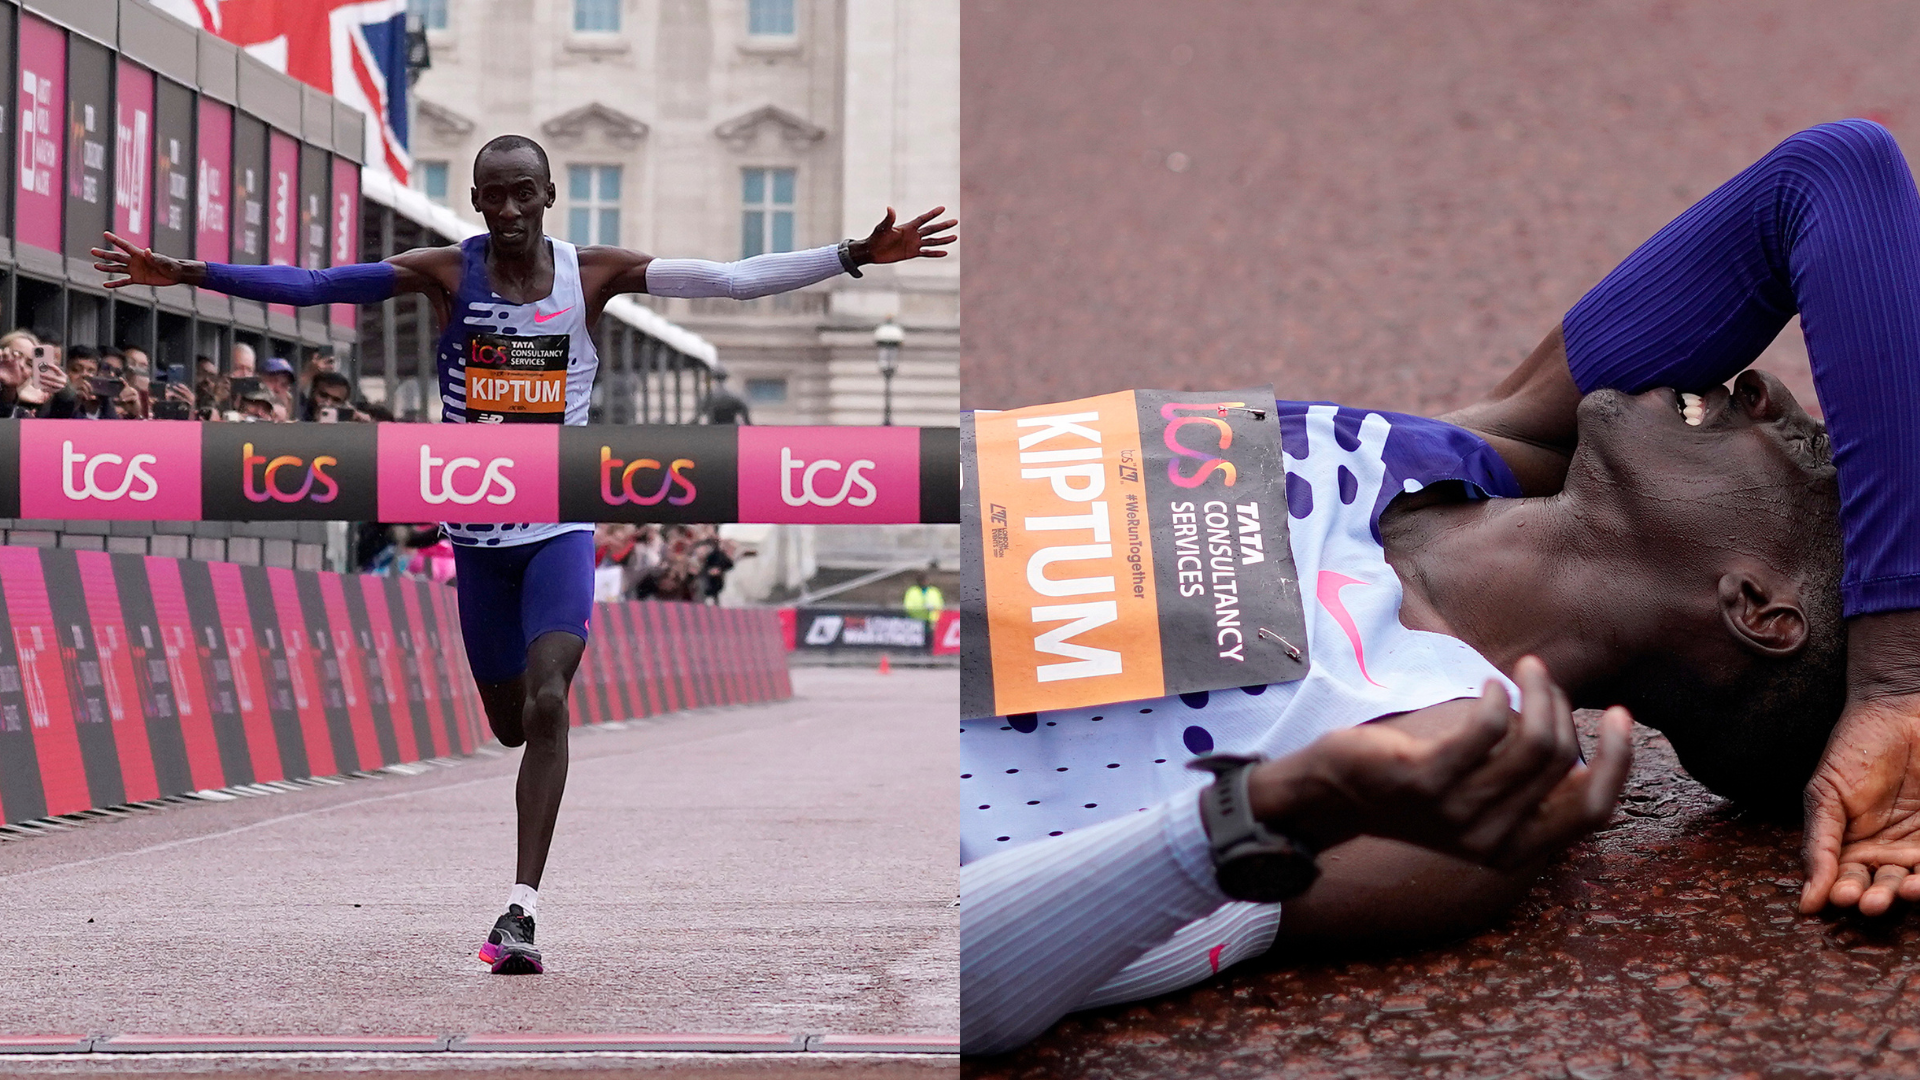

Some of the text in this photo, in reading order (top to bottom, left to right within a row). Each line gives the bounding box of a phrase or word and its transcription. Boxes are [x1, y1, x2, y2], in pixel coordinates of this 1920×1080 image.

[472, 339, 507, 364] tcs
[511, 341, 534, 349] TATA
[511, 349, 563, 358] CONSULTANCY
[511, 357, 545, 366] SERVICES
[472, 377, 560, 403] KIPTUM
[62, 440, 158, 501] tcs
[242, 443, 338, 503] tcs
[420, 444, 516, 504] tcs
[600, 445, 697, 506] tcs
[1161, 402, 1245, 488] tcs
[780, 446, 877, 507] tcs
[1016, 411, 1123, 683] KIPTUM
[1125, 494, 1146, 599] #WeRunTogether
[1171, 501, 1205, 598] SERVICES
[1236, 501, 1265, 566] TATA
[1203, 500, 1245, 662] CONSULTANCY
